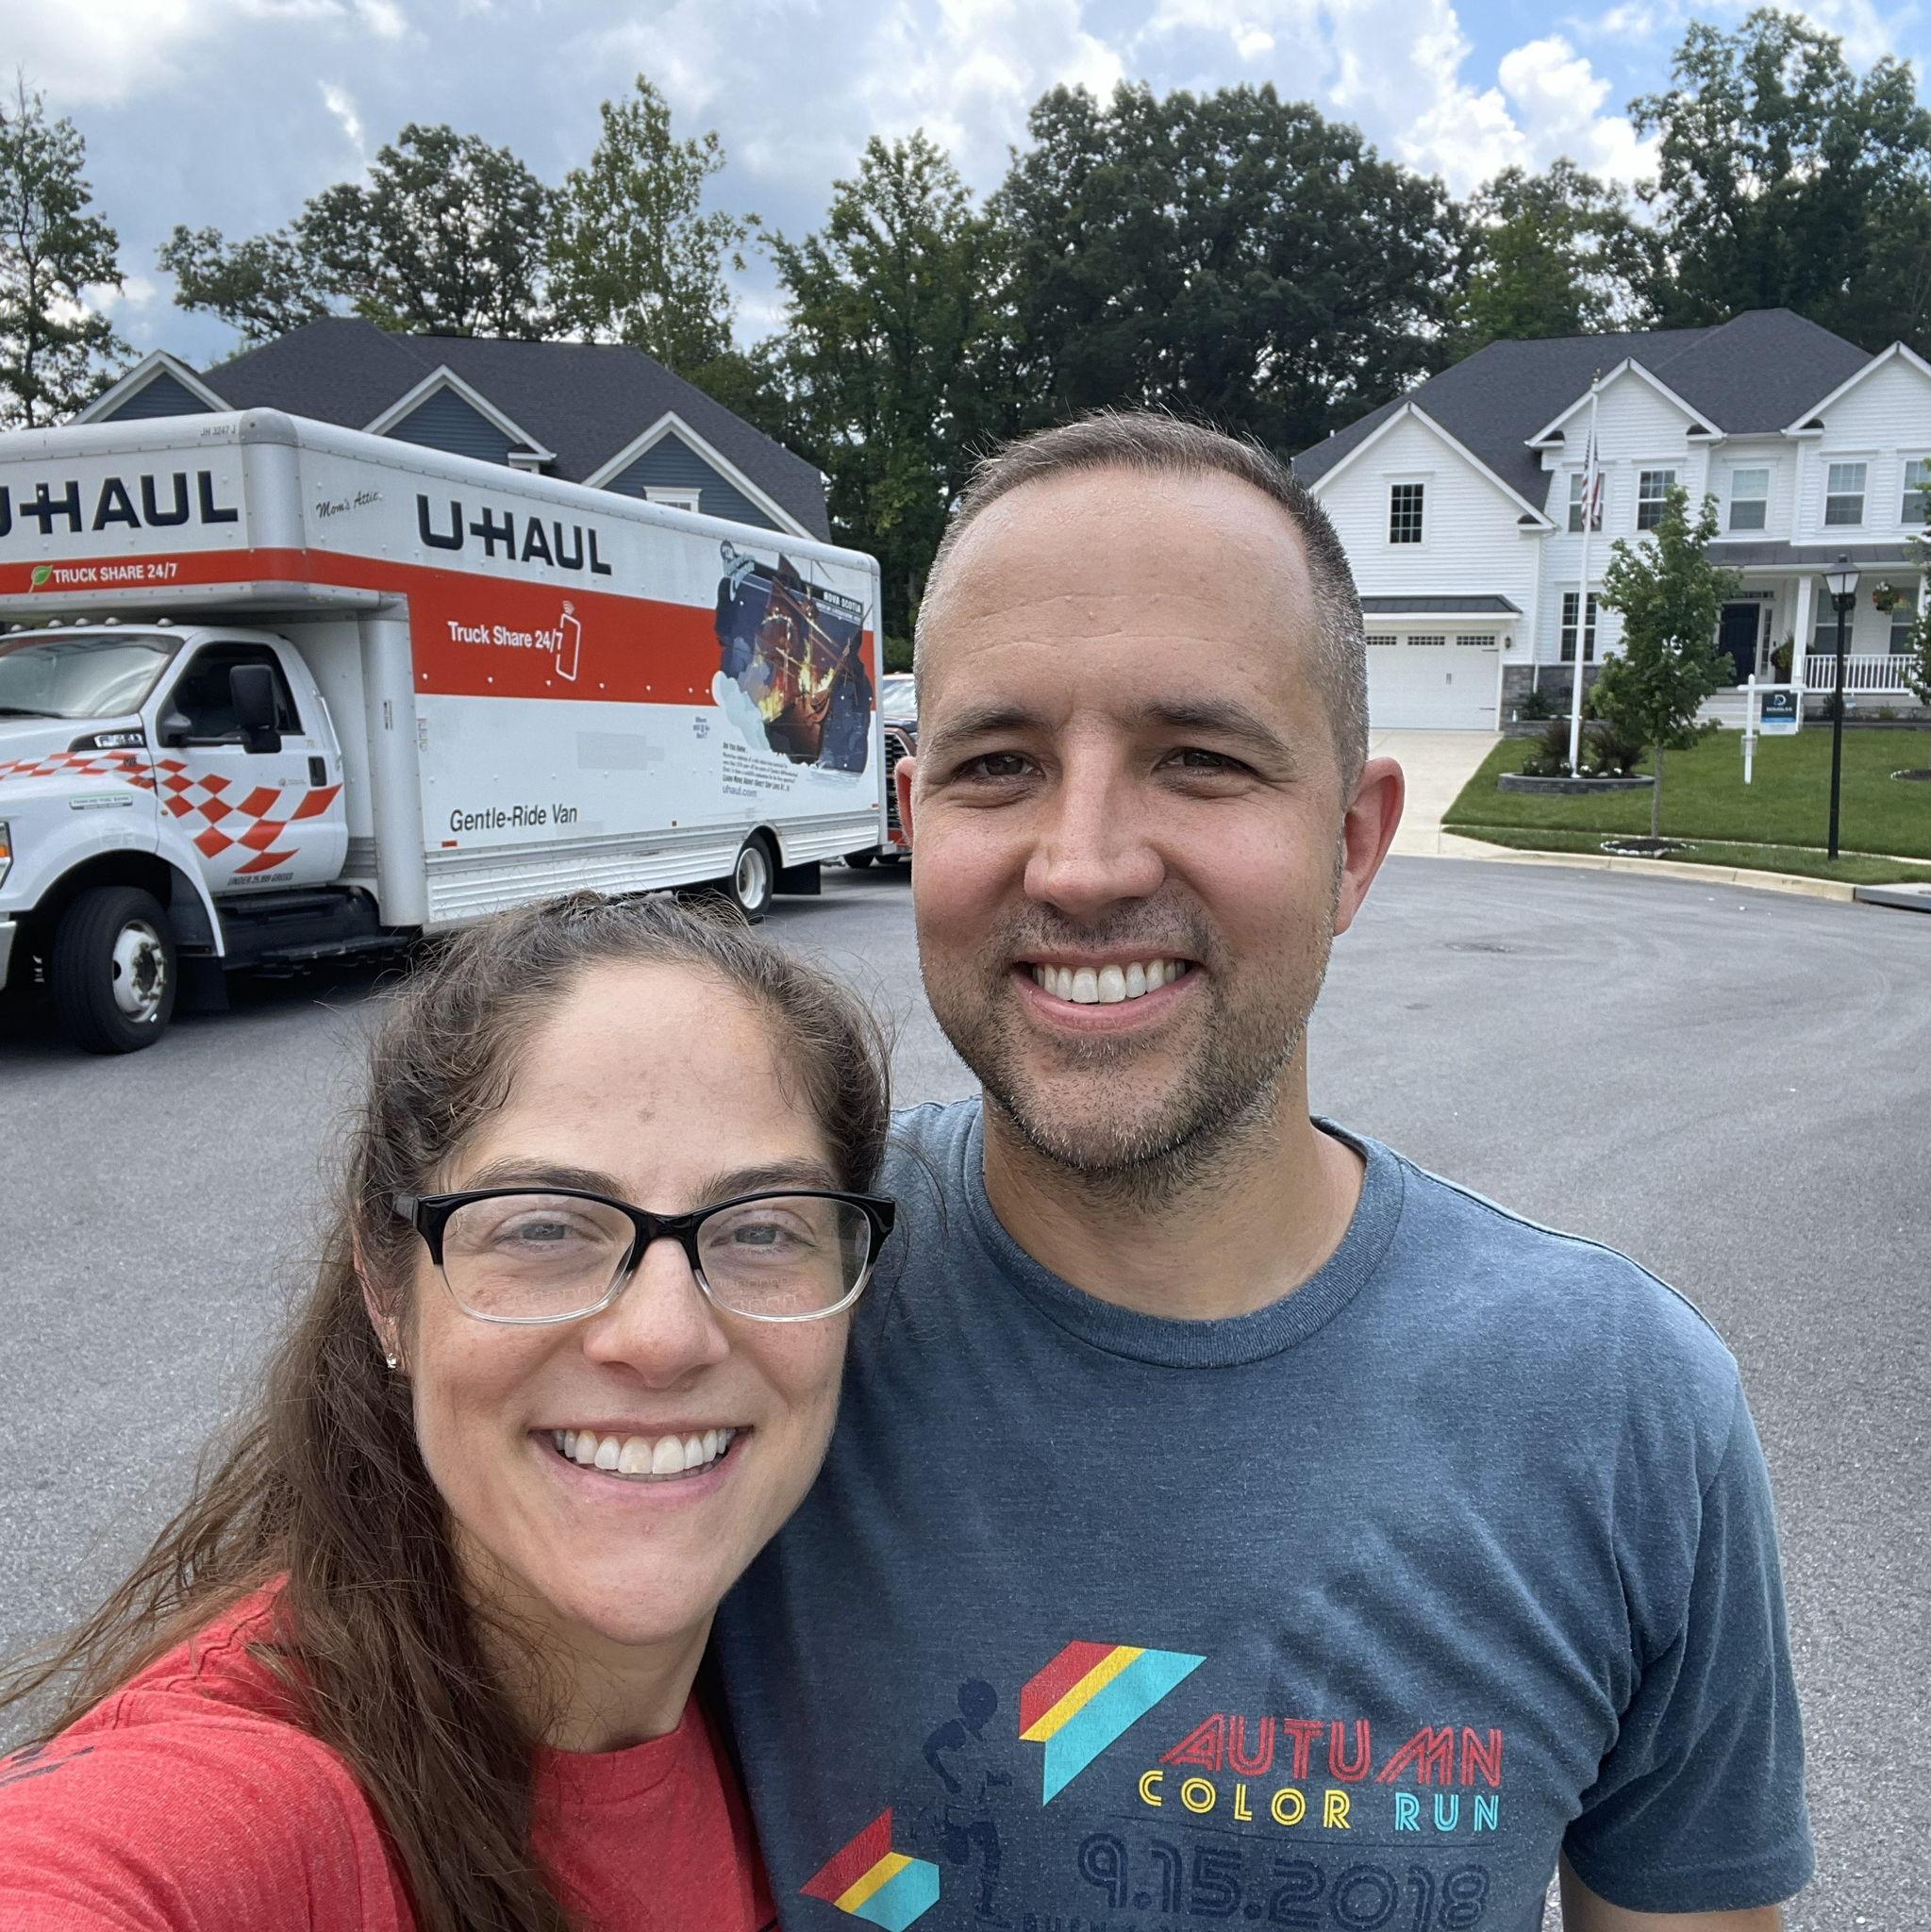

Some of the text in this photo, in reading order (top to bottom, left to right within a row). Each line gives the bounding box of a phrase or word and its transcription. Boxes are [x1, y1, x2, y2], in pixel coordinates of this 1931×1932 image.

[0, 470, 240, 538] -HAUL
[316, 490, 379, 519] Mom's Attic
[416, 493, 612, 576] U-HAUL
[53, 562, 178, 584] TRUCK SHARE 24/7
[447, 621, 564, 654] Truck Share 24/7
[723, 785, 757, 797] uhaul.com
[450, 803, 577, 832] Gentle-Ride Van
[1158, 1713, 1503, 1788] AUTUMN
[1139, 1770, 1500, 1832] COLOR RUN
[1078, 1832, 1490, 1932] 9.15.2018
